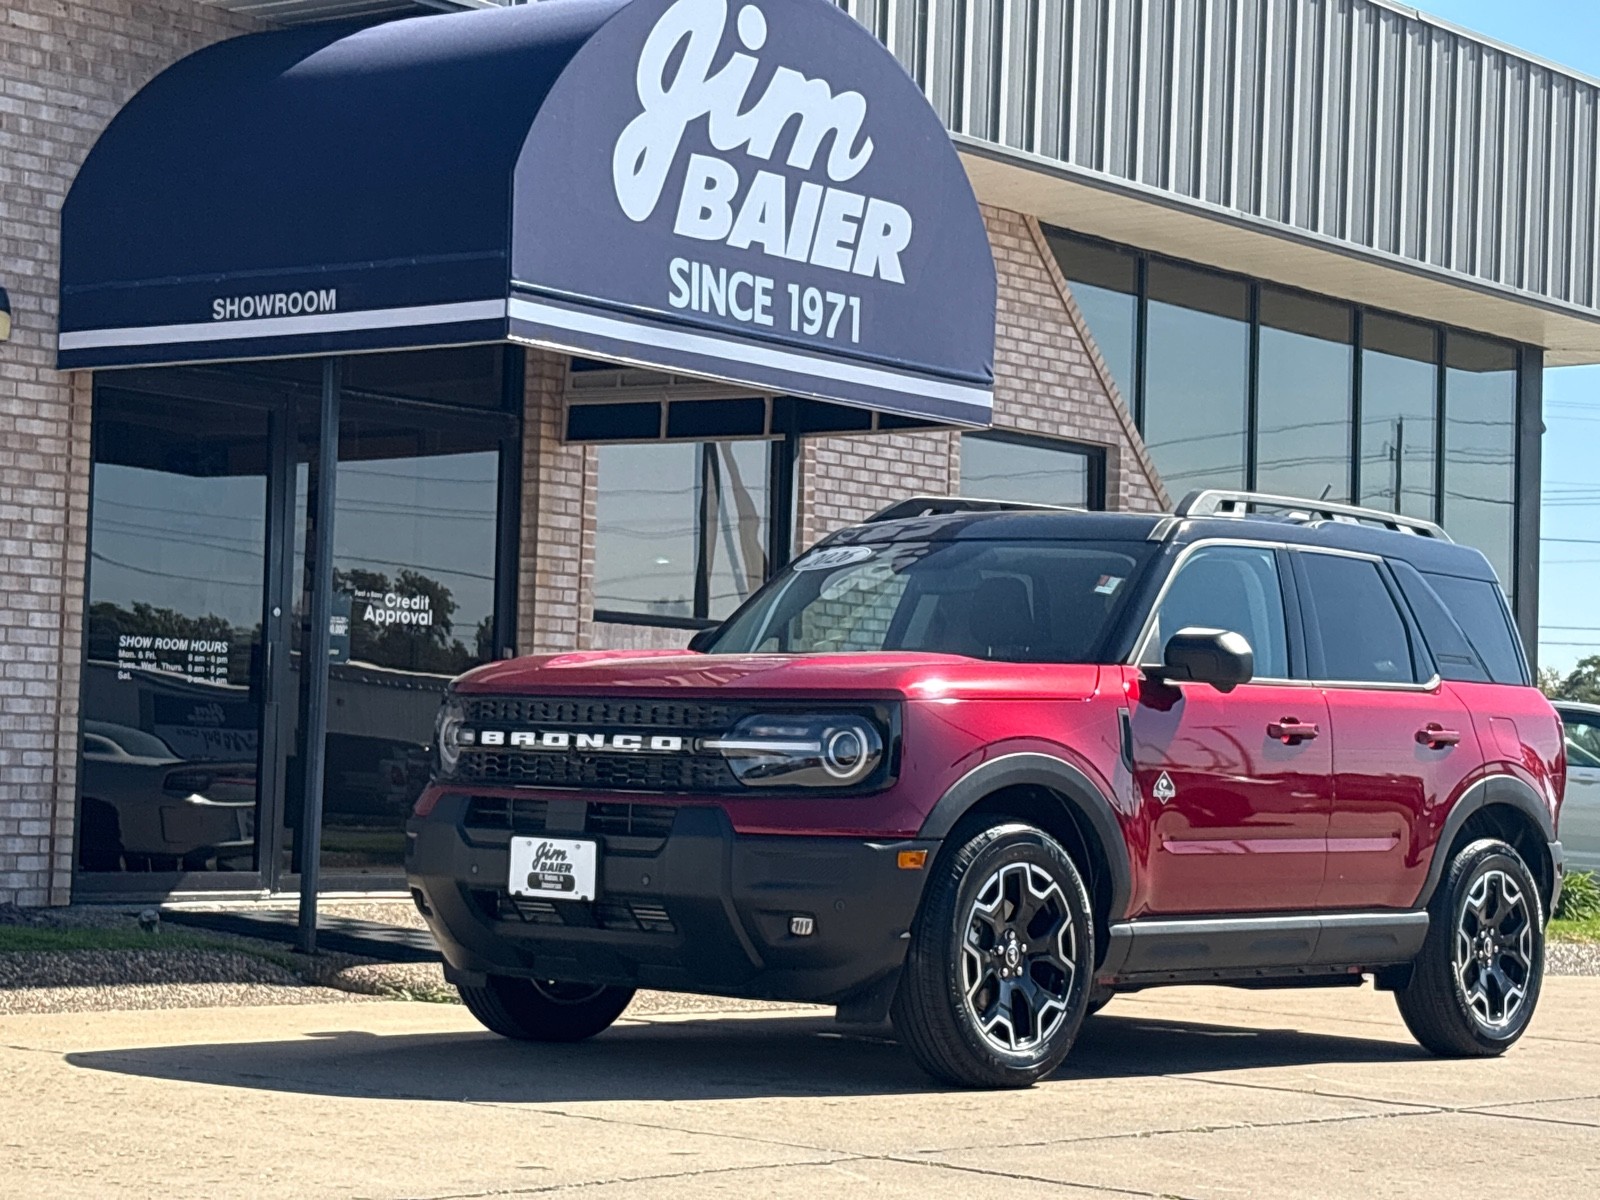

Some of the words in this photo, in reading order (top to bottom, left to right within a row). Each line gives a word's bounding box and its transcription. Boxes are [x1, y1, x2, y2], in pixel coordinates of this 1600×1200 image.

[612, 0, 874, 222] Jim
[673, 153, 913, 285] BAIER
[212, 288, 337, 320] SHOWROOM
[669, 257, 774, 327] SINCE
[787, 283, 861, 344] 1971
[384, 592, 430, 610] Credit
[363, 604, 433, 626] Approval
[119, 635, 153, 648] SHOW
[154, 637, 189, 651] ROOM
[190, 639, 228, 653] HOURS
[481, 730, 682, 751] BRONCO
[532, 841, 568, 871] Jim
[540, 861, 573, 873] BAIER
